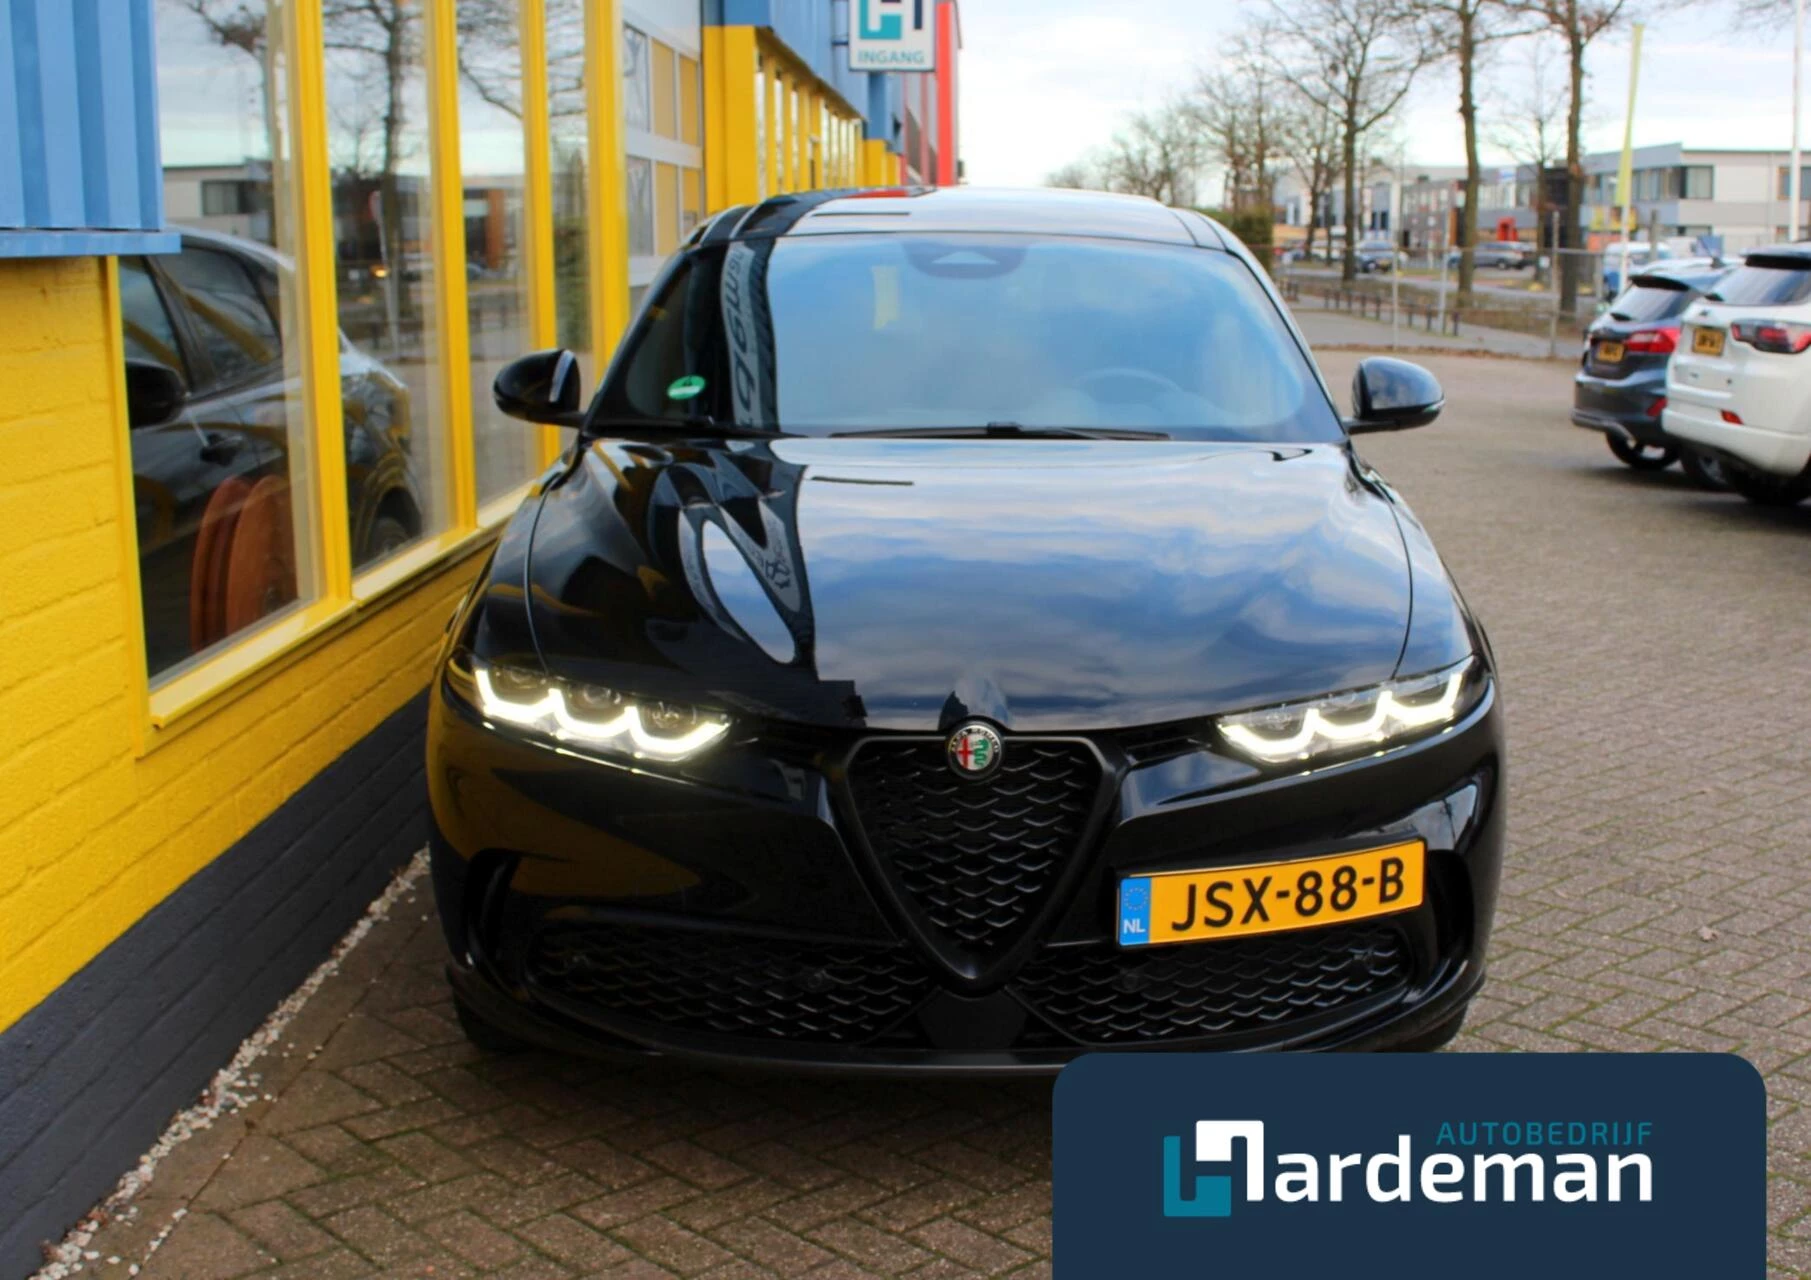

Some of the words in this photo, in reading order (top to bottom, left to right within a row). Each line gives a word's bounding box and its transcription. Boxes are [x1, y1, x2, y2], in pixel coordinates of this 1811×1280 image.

[857, 51, 925, 64] INGANG
[1171, 857, 1405, 932] JSX-88-B
[1123, 919, 1146, 934] NL
